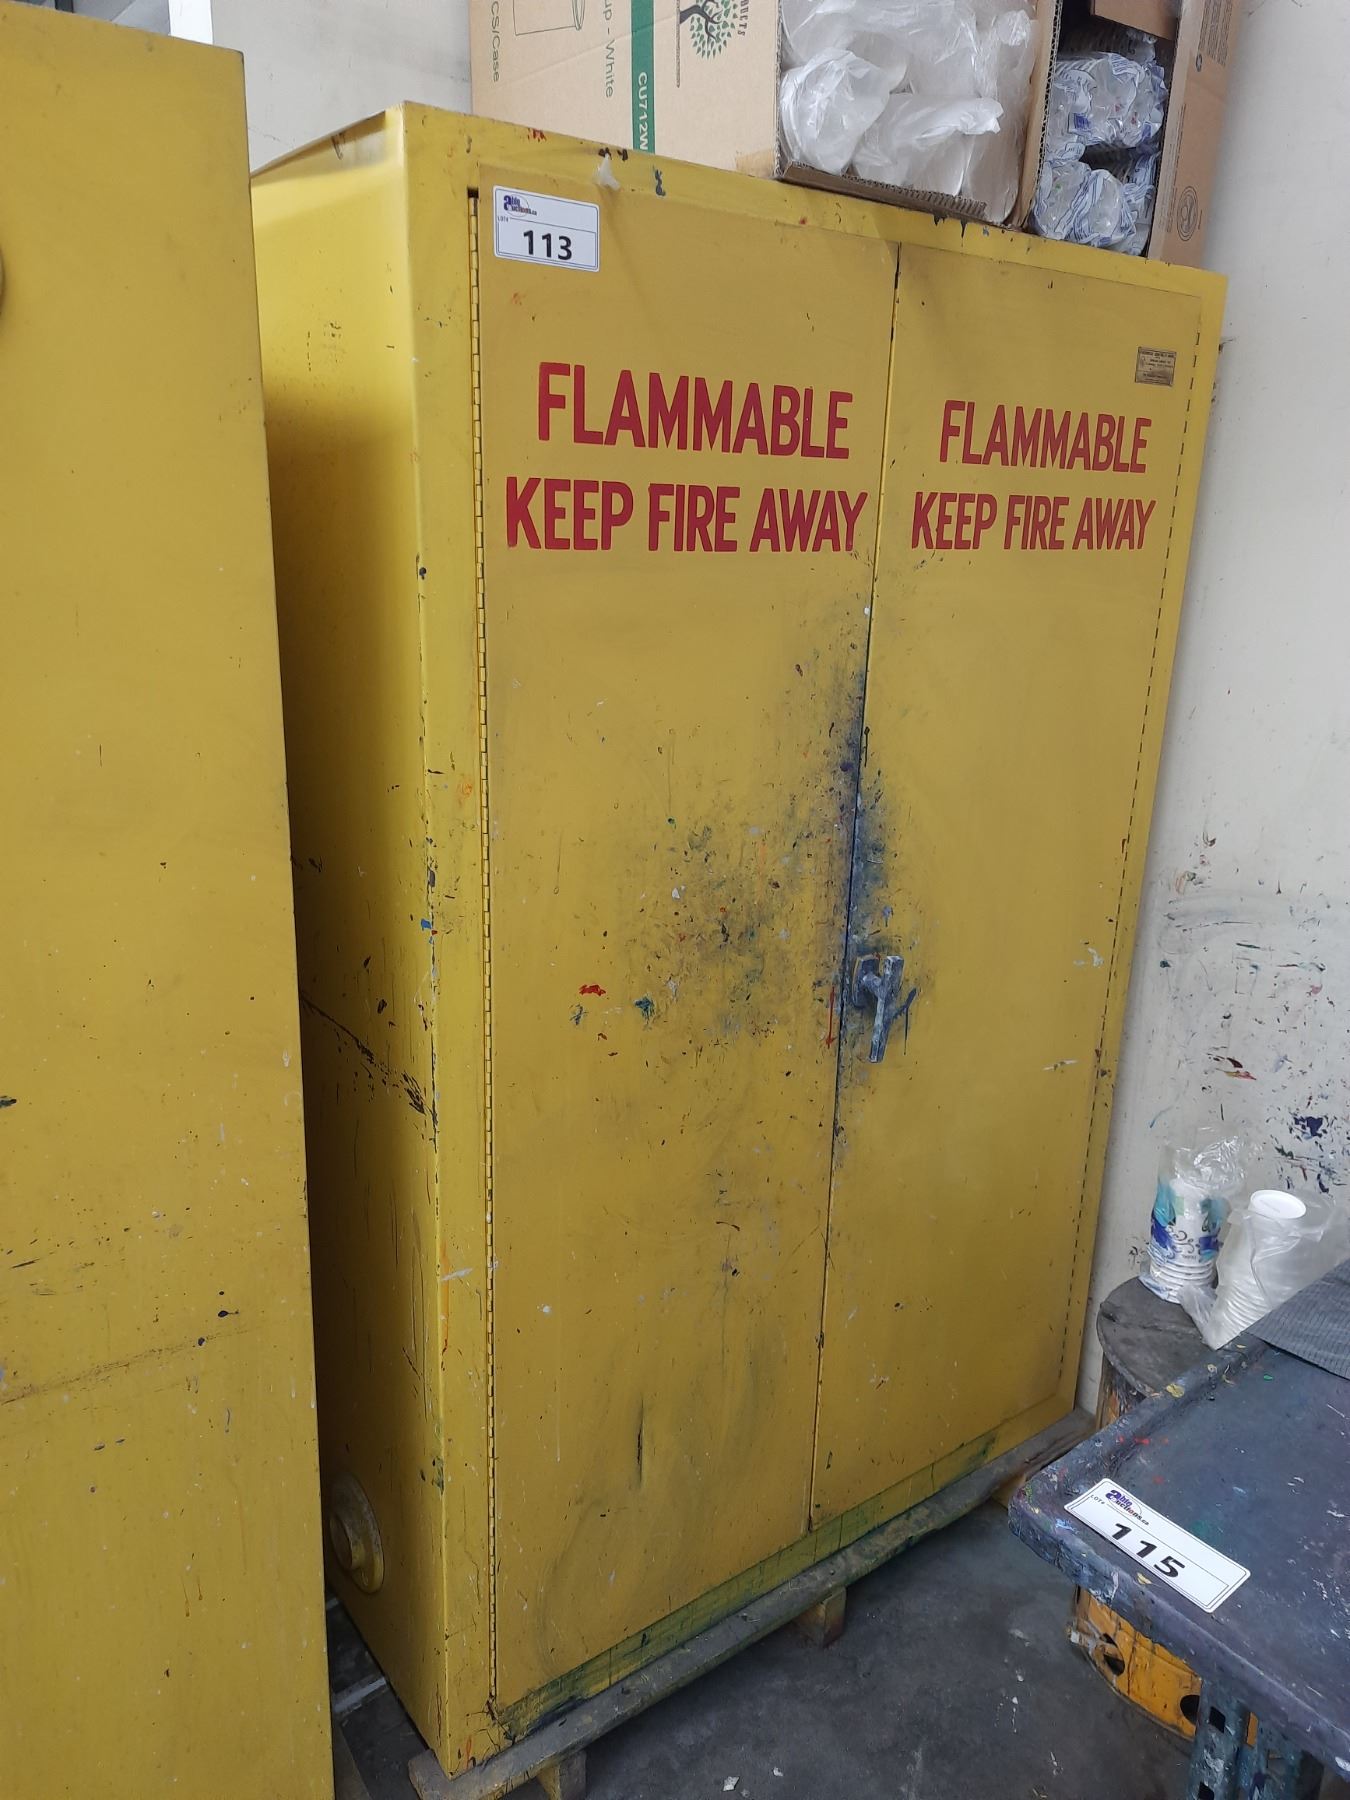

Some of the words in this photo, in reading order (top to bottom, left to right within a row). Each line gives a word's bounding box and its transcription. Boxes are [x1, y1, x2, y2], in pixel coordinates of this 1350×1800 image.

[605, 39, 616, 98] White
[638, 72, 649, 150] CU712W
[523, 230, 572, 261] 113
[538, 362, 853, 459] FLAMMABLE
[939, 400, 1152, 473] FLAMMABLE
[506, 476, 634, 550] KEEP
[648, 483, 740, 552] FIRE
[749, 488, 868, 552] AWAY
[911, 491, 998, 550] KEEP
[1003, 495, 1070, 550] FIRE
[1072, 497, 1156, 550] AWAY
[1112, 1523, 1185, 1578] 115
